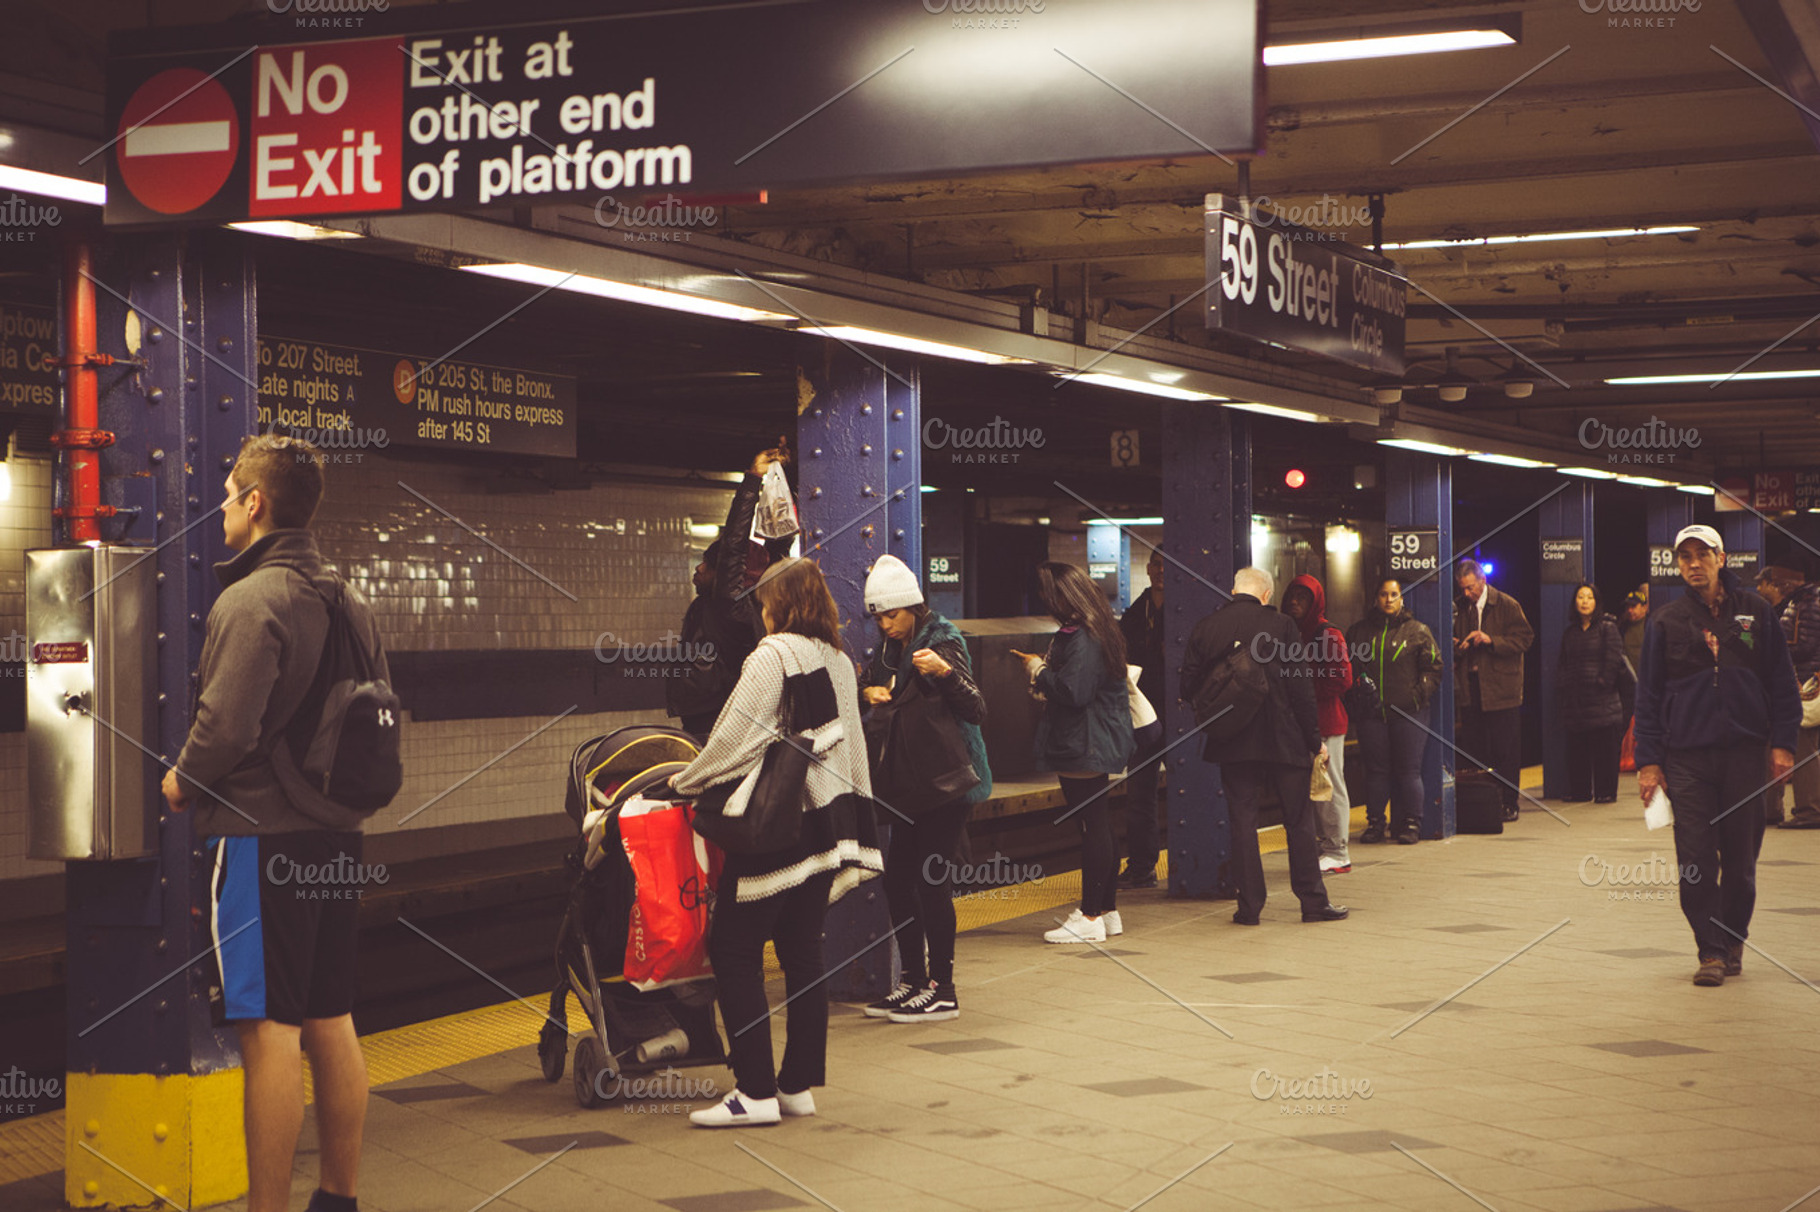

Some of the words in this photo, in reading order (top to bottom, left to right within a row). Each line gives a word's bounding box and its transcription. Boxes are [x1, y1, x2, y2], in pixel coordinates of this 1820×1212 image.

[410, 35, 503, 88] Exit
[523, 31, 573, 80] at
[257, 51, 349, 118] No
[408, 93, 540, 144] other
[559, 77, 655, 134] end
[256, 128, 382, 200] Exit
[407, 149, 460, 201] of
[479, 139, 691, 204] platform
[1221, 216, 1258, 305] 59
[1268, 233, 1339, 328] Street
[1352, 263, 1406, 319] Columbus
[1351, 312, 1383, 357] Circle
[277, 342, 308, 370] 207
[312, 346, 363, 377] Street.
[258, 371, 288, 397] ate
[293, 374, 339, 405] nights
[346, 384, 355, 401] A
[400, 369, 411, 394] D
[417, 361, 434, 385] To
[438, 363, 466, 389] 205
[491, 371, 512, 394] the
[516, 373, 555, 400] Bronx.
[278, 402, 312, 427] local
[316, 407, 352, 431] track
[417, 387, 439, 412] PM
[442, 393, 471, 416] rush
[475, 394, 511, 420] hours
[515, 403, 564, 427] express
[417, 417, 448, 440] after
[451, 420, 473, 442] 145
[476, 422, 491, 444] St
[1117, 435, 1133, 461] 8
[1755, 472, 1780, 489] No
[1755, 491, 1789, 507] Exit
[1390, 534, 1420, 554] 59
[1543, 542, 1582, 552] Columbus
[1543, 551, 1566, 560] Circle
[1651, 549, 1673, 565] 59
[930, 558, 949, 573] 59
[1391, 555, 1437, 570] Street
[929, 572, 959, 583] Street
